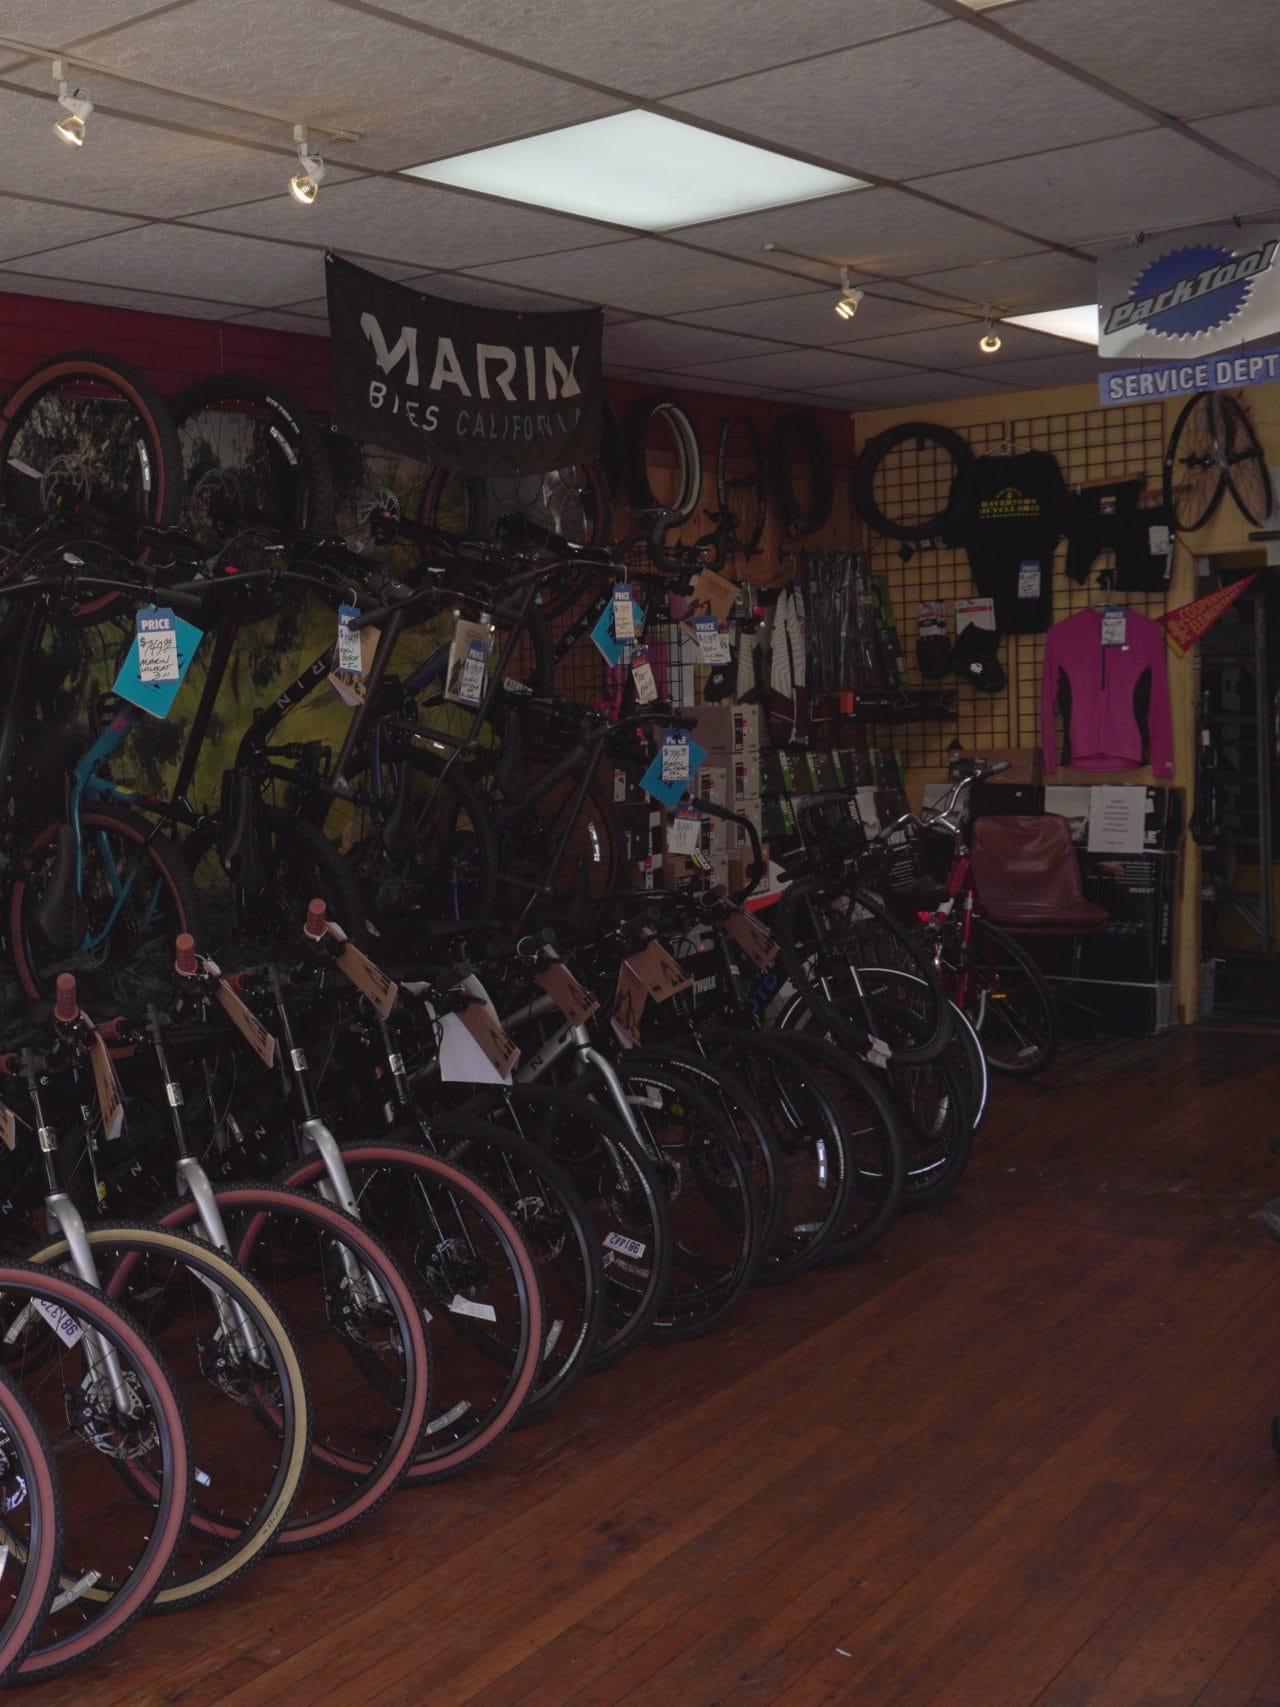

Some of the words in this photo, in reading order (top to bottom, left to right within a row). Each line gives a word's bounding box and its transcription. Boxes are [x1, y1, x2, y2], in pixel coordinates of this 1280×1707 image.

[360, 312, 582, 401] MARIN
[1110, 364, 1209, 400] SERVICE
[1216, 353, 1280, 385] DEPT
[370, 380, 439, 431] BIES
[141, 618, 170, 630] PRICE
